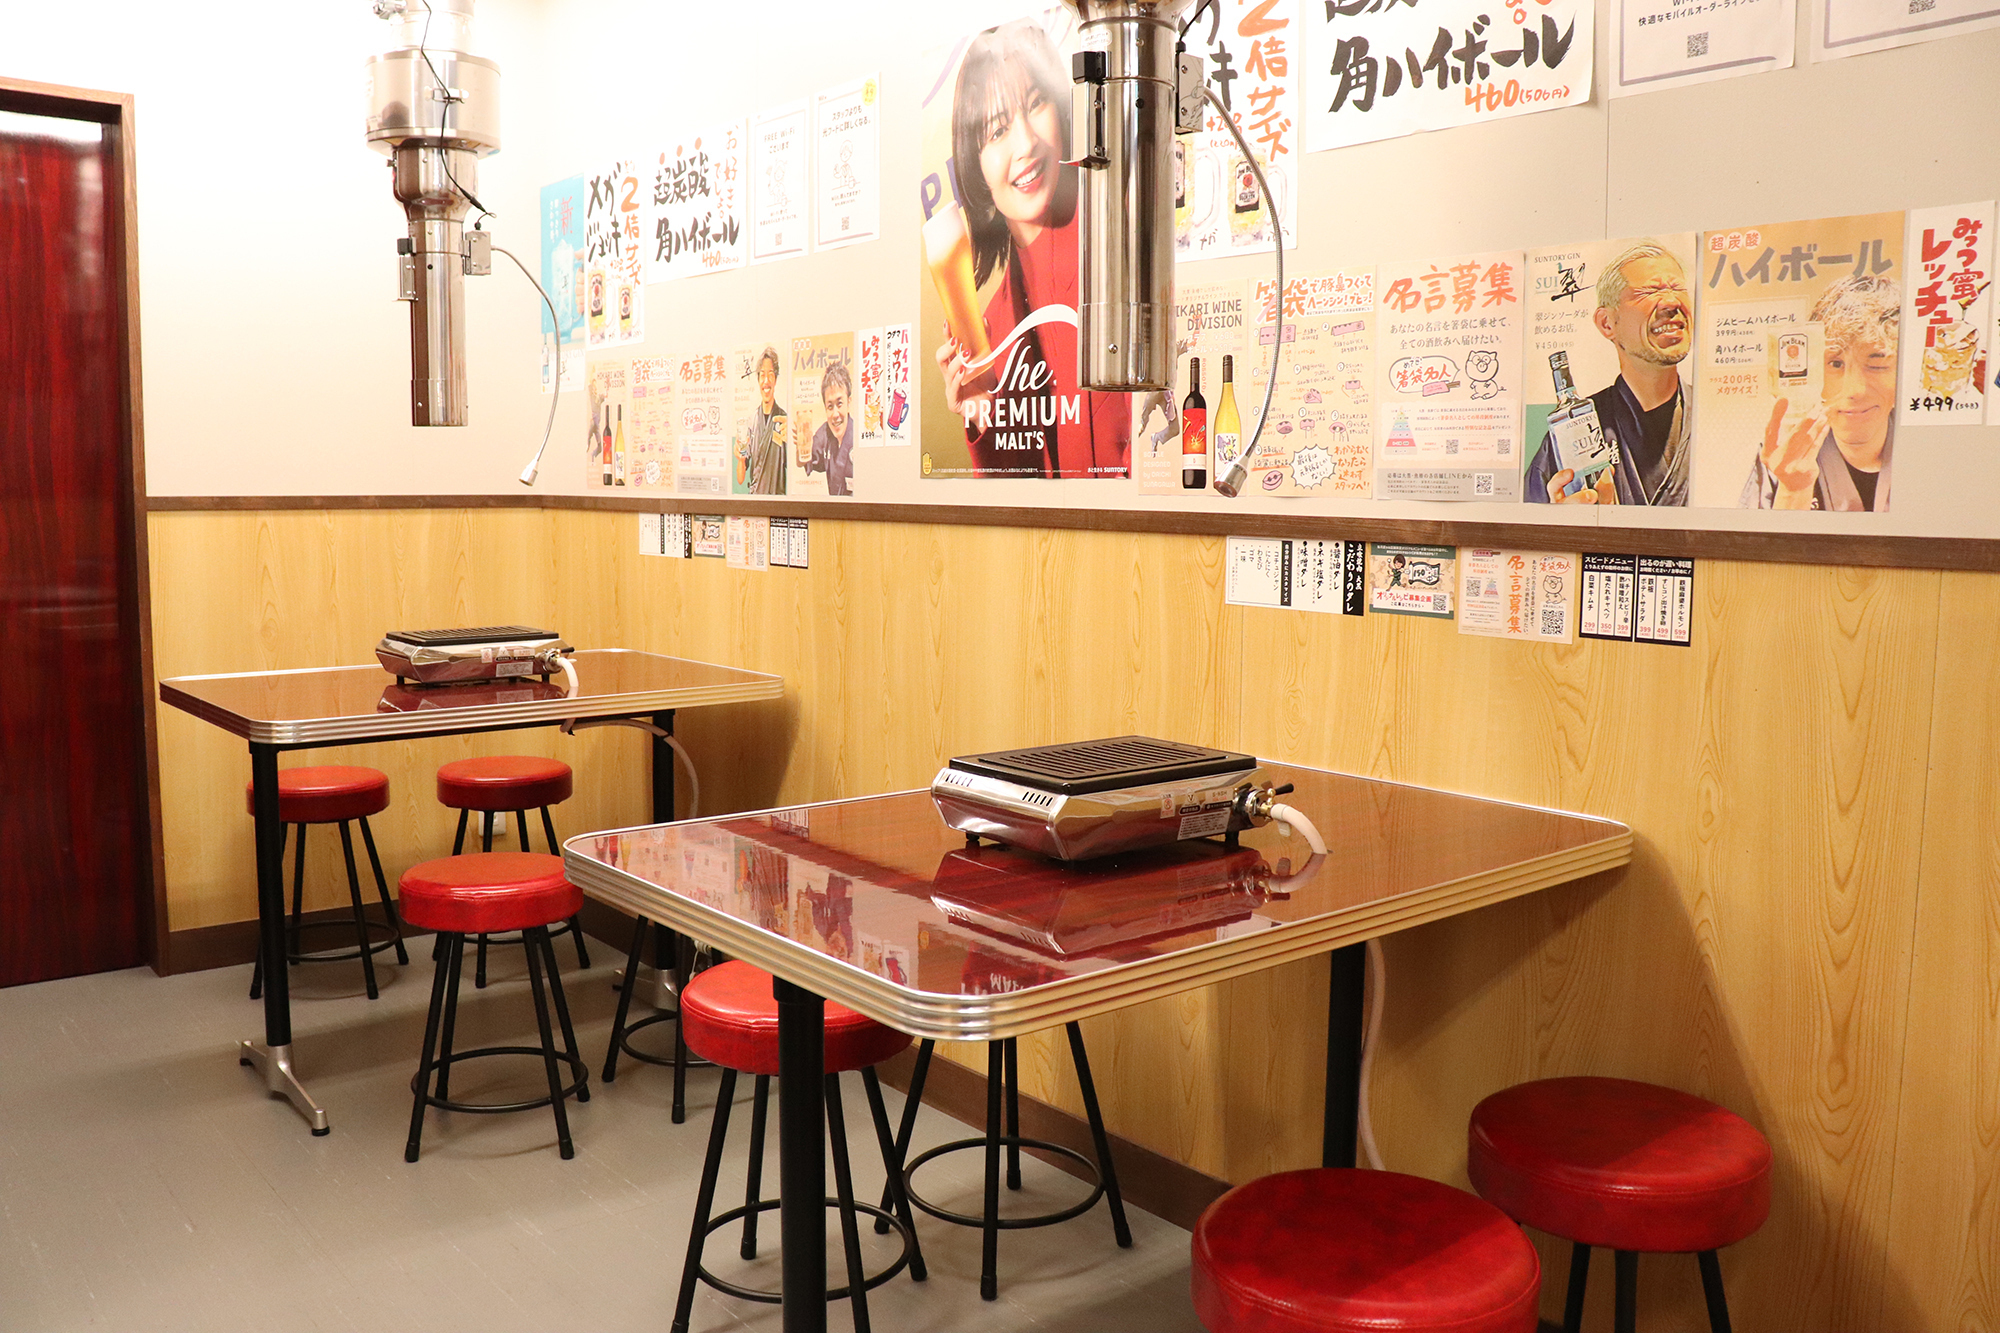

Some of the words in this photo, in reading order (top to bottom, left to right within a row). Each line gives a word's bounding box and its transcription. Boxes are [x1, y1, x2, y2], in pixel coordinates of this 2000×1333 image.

[1328, 11, 1576, 113] 角ハイボール
[655, 211, 740, 264] 角ハイボール
[1711, 232, 1760, 252] 超炭酸
[1535, 254, 1567, 263] SUNTORY
[1567, 252, 1581, 260] GIN
[1709, 238, 1894, 289] ハイボール
[1382, 259, 1518, 315] 名言募集
[1535, 276, 1559, 290] SUI
[1914, 228, 1954, 348] レッチュー
[1175, 302, 1210, 318] IKARI
[1211, 298, 1243, 315] WINE
[1186, 314, 1243, 332] DIVISION
[1390, 316, 1511, 335] あなたの名言を箸袋に乗せて、
[1534, 322, 1578, 335] 飲めるお店。
[1716, 312, 1797, 327] ジムビームハイボール
[1399, 334, 1503, 351] 全ての酒飲みへ届けたい。
[1715, 343, 1763, 355] 角ハイボール
[678, 352, 727, 385] 名言募集
[793, 346, 852, 372] ハイボール
[1395, 362, 1453, 392] 箸袋名人
[964, 394, 1081, 429] PREMIUM
[995, 431, 1045, 450] MALT'S
[1334, 444, 1369, 456] わからなく
[1104, 466, 1128, 474] SUNTORY
[1338, 456, 1367, 468] なったら
[1584, 556, 1635, 565] スピードメニュー
[1345, 543, 1356, 613] こだわりのタレ
[1506, 554, 1526, 634] 名言募集
